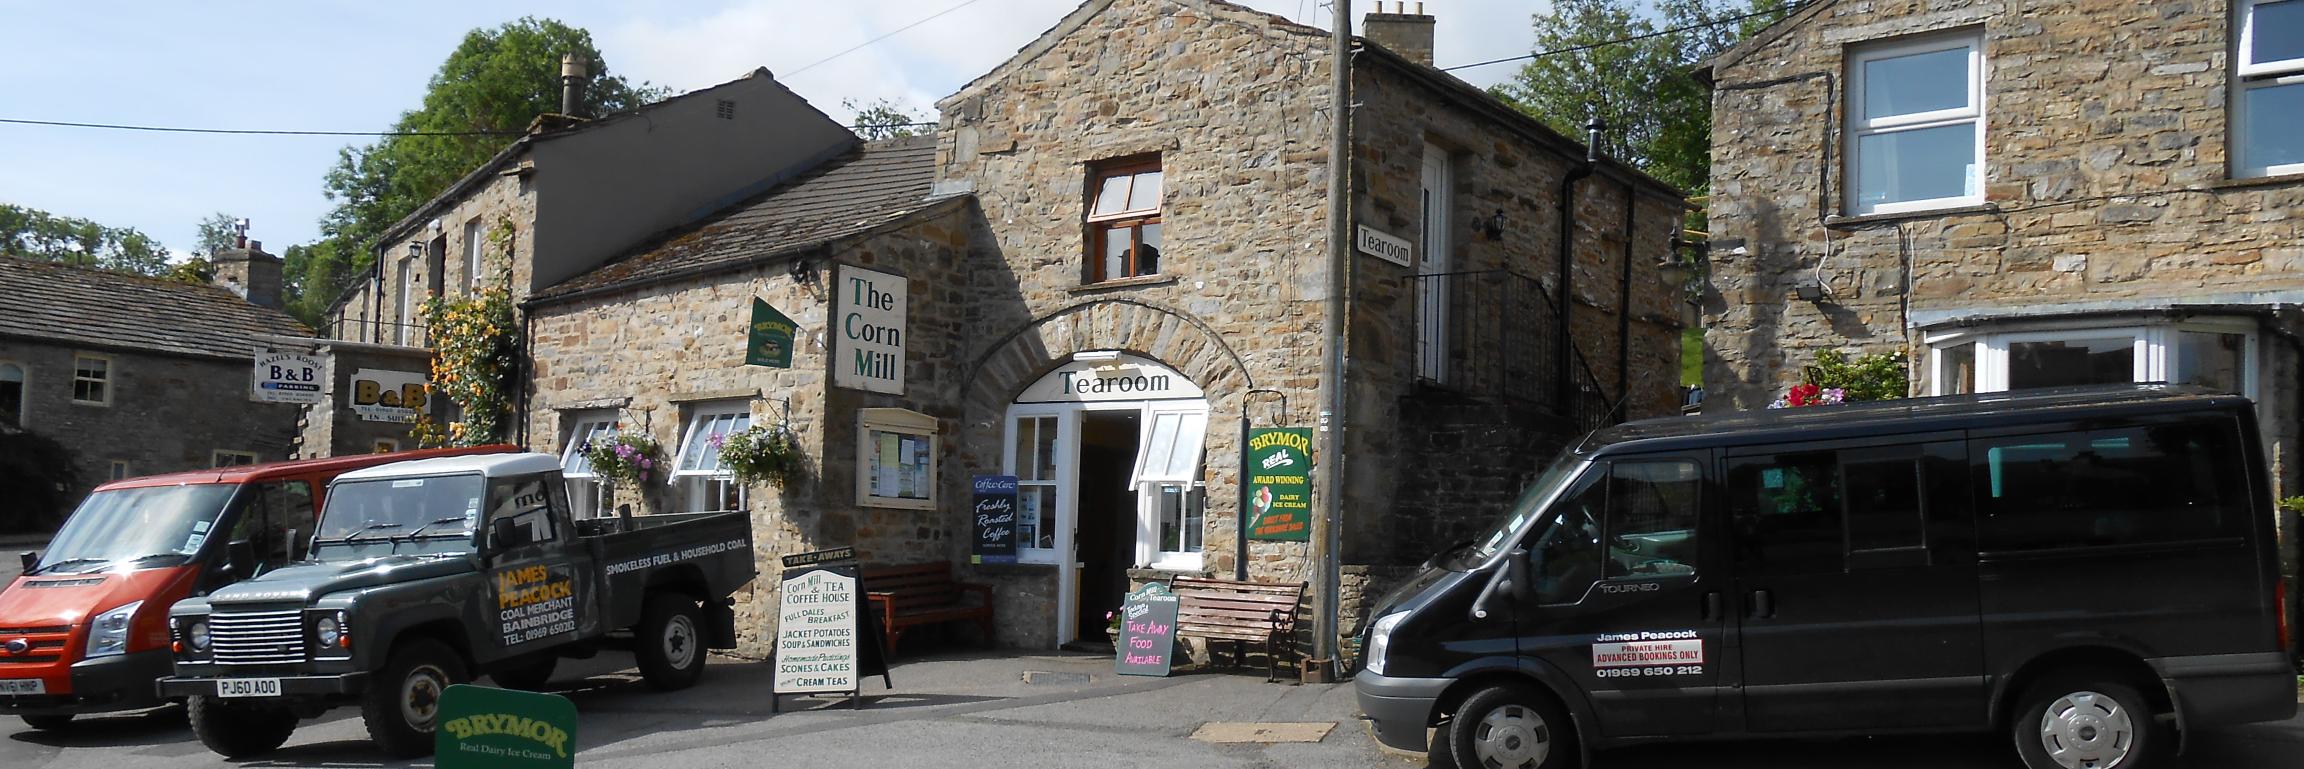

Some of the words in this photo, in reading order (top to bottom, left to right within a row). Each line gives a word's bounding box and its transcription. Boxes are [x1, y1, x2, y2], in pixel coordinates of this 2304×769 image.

[1361, 228, 1408, 262] Tearoom
[849, 276, 893, 311] The
[845, 312, 899, 347] Corn
[854, 347, 896, 380] Mill
[1058, 370, 1169, 395] Tearoom
[1249, 431, 1308, 456] BRYMOR
[1262, 449, 1289, 469] REAL
[1253, 475, 1274, 484] AWARD
[1275, 475, 1304, 485] WINNING
[976, 498, 1011, 513] Freshly
[977, 512, 1014, 527] Roasted
[982, 527, 1010, 541] Coffee
[606, 557, 651, 575] SMOKELESS
[652, 552, 671, 566] FUEL
[673, 551, 680, 561] &
[681, 542, 725, 560] HOUSEHOLD
[727, 538, 746, 550] COAL
[498, 564, 547, 590] JAMES
[787, 581, 806, 594] Corn
[808, 574, 821, 587] Mill
[498, 579, 571, 608] PEACOCK
[811, 586, 819, 594] &
[824, 581, 844, 592] TEA
[1599, 583, 1660, 593] TOURNEO
[786, 594, 819, 604] COFFEE
[822, 592, 850, 603] HOUSE
[1130, 592, 1146, 601] Corn
[1150, 594, 1176, 602] Tearoom
[501, 607, 525, 621] COAL
[527, 596, 574, 615] MERCHANT
[784, 612, 801, 622] FULL
[802, 608, 825, 617] DALES
[503, 608, 574, 633] BAINBRIDGE
[807, 611, 849, 624] BREAKFAST
[504, 633, 523, 646] TEL:
[525, 628, 548, 641] 01969
[550, 621, 575, 635] 650212
[783, 629, 812, 639] JACKET
[813, 628, 850, 637] POTATOES
[1127, 620, 1146, 633] TAKE
[1147, 620, 1169, 635] AWAY
[1130, 636, 1153, 649] FOOD
[1597, 632, 1639, 641] James
[1641, 630, 1697, 640] Peacock
[782, 640, 801, 649] SOUP
[806, 639, 850, 648] SANDWICHES
[1125, 651, 1162, 664] AVAILABLE
[1597, 653, 1637, 662] ADVANCED
[1640, 651, 1678, 661] BOOKINGS
[1680, 650, 1698, 659] ONLY
[781, 664, 813, 673] SCONES
[820, 662, 850, 672] CAKES
[1596, 668, 1641, 678] 01969
[1643, 667, 1674, 676] 650
[1677, 666, 1703, 675] 212
[222, 681, 251, 695] PJ60
[796, 677, 825, 687] CREAM
[826, 677, 848, 686] TEAS
[444, 713, 568, 758] BRYMOR
[460, 742, 480, 752] Real
[481, 744, 506, 757] Dairy
[508, 748, 521, 758] Ice
[522, 749, 551, 760] Cream
